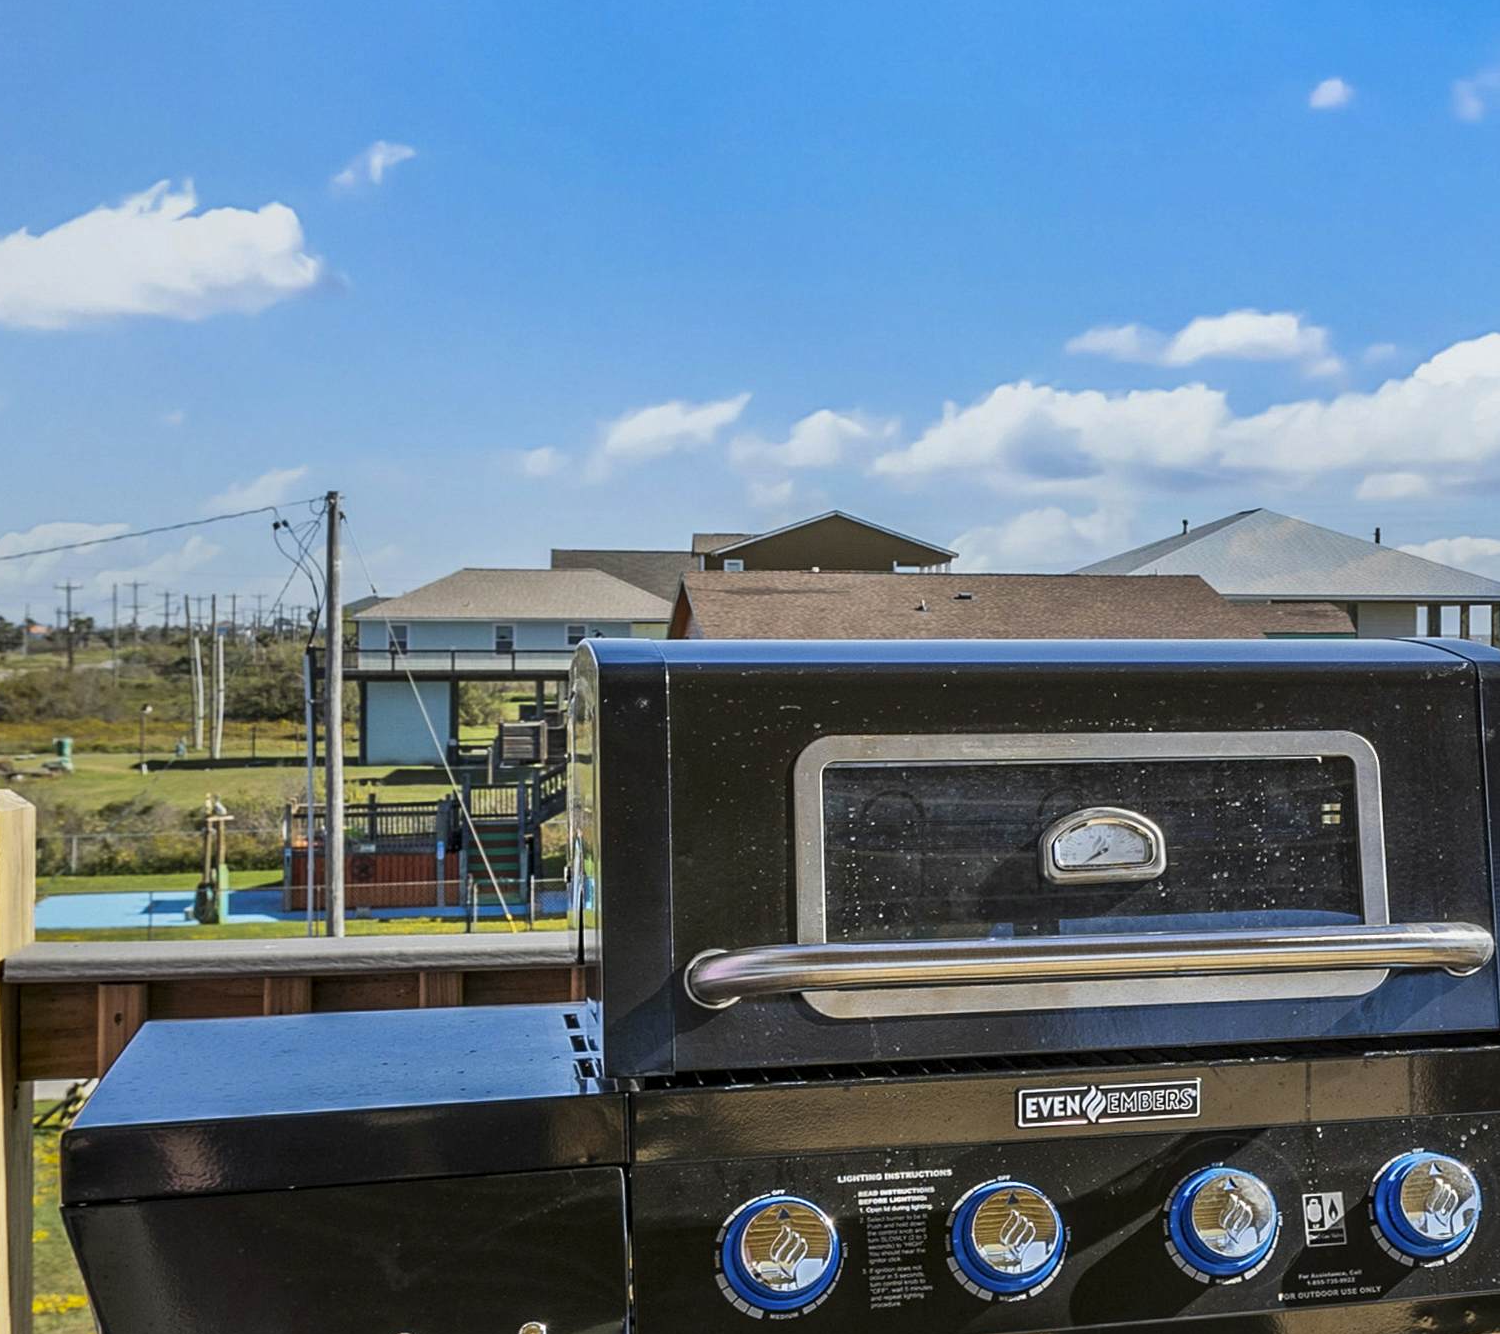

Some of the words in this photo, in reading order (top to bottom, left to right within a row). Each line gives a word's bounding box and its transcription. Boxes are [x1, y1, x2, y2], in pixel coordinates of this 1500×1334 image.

[1026, 1095, 1080, 1118] EVEN
[837, 1173, 882, 1183] LIGHTING
[884, 1169, 953, 1181] INSTRUCTIONS
[858, 1190, 879, 1198] READ
[880, 1186, 935, 1196] INSTRUCTIONS
[858, 1198, 888, 1206] BEFORE
[1278, 1292, 1296, 1301] FOR
[1297, 1289, 1340, 1300] OUTDOOR
[1340, 1287, 1358, 1295] USE
[1359, 1285, 1382, 1294] ONLY
